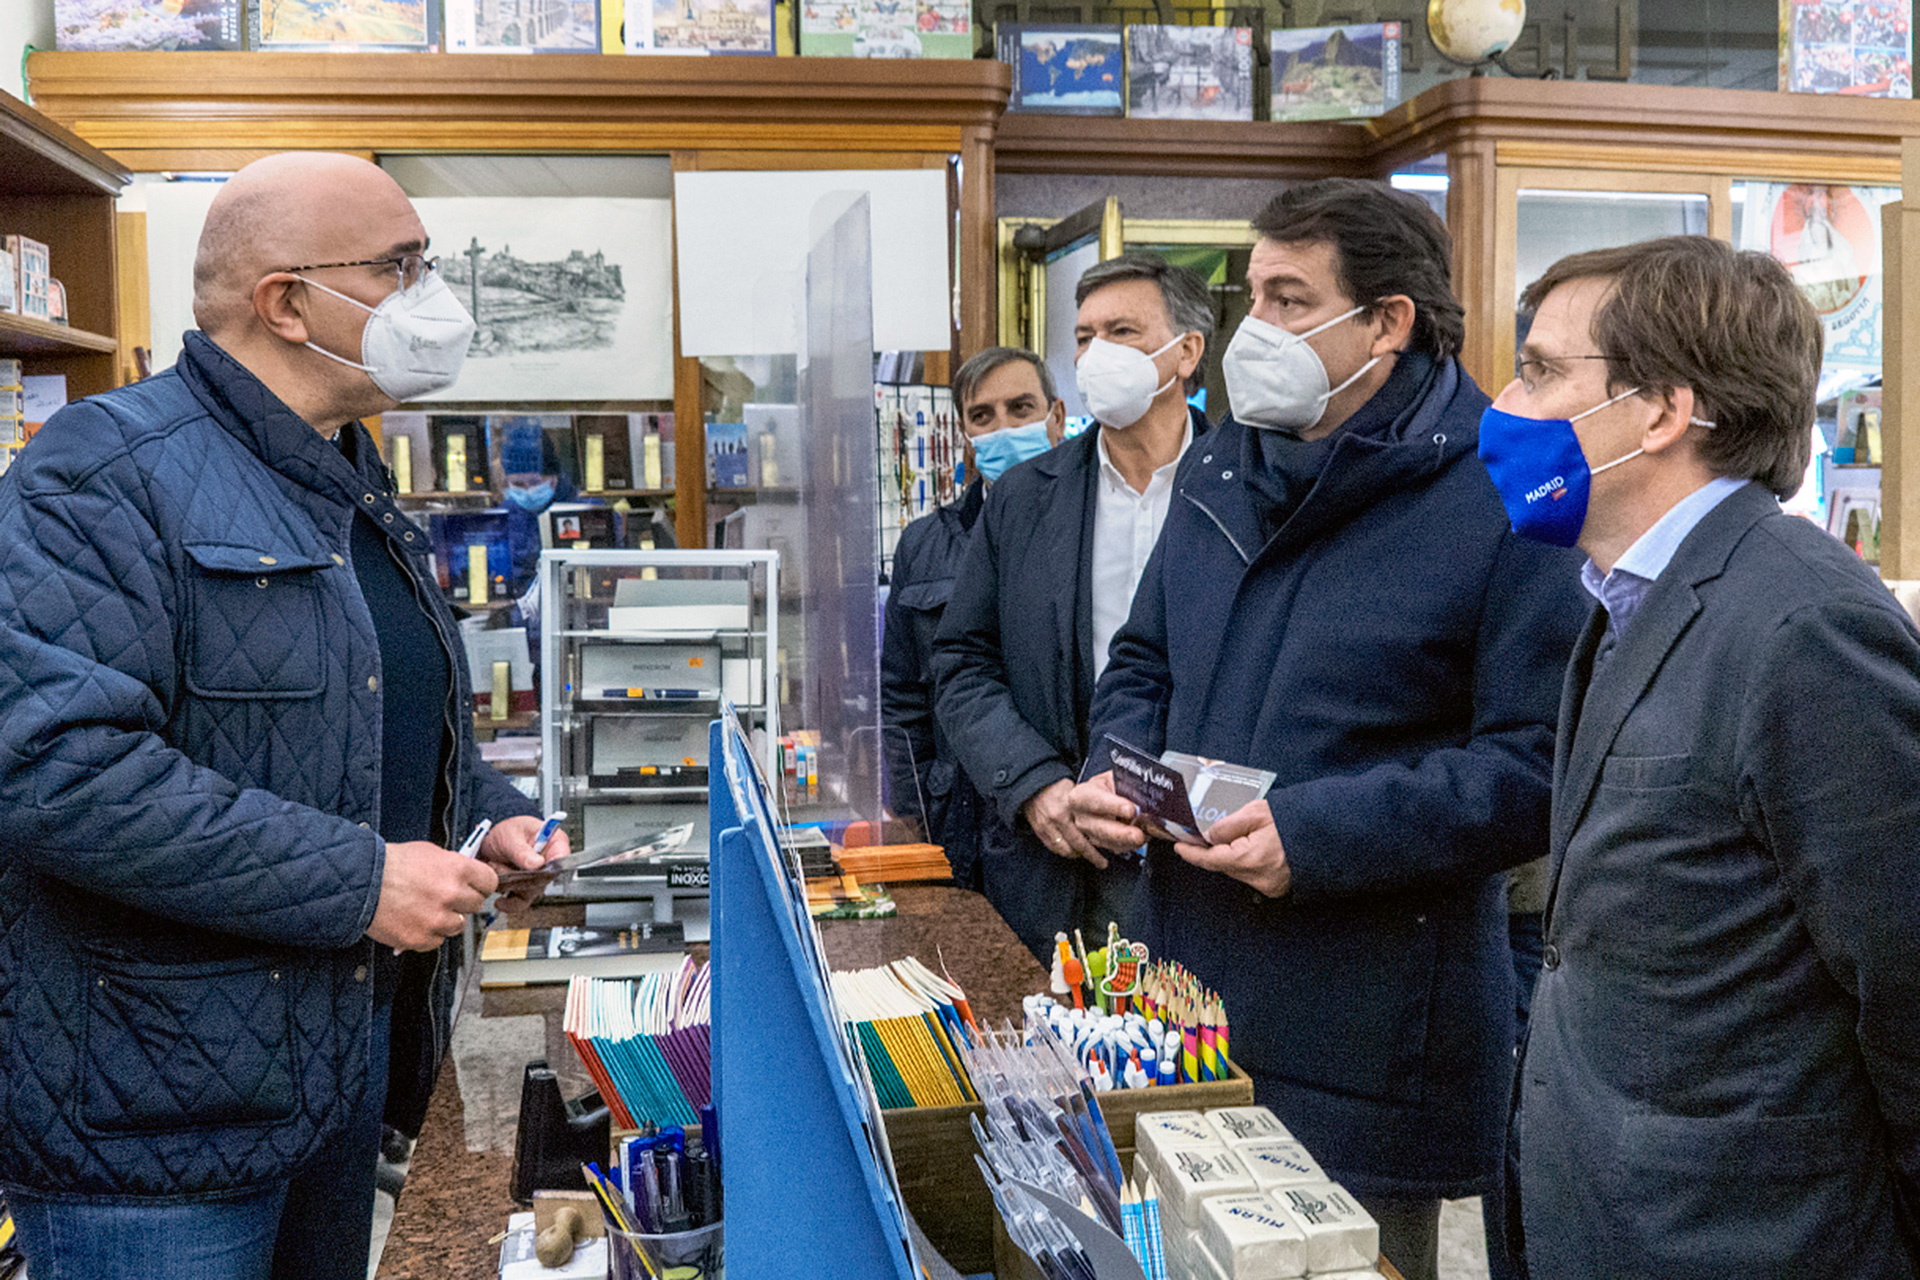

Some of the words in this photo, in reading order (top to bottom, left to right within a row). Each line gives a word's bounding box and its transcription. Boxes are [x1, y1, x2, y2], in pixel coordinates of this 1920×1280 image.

[220, 6, 230, 40] EDUCA
[229, 6, 238, 43] PUZZLE
[1237, 45, 1251, 78] 1000
[1387, 40, 1398, 73] 1000
[1524, 475, 1565, 504] MADRID
[1160, 1120, 1209, 1141] MILAN
[1258, 1151, 1311, 1175] MILAN
[1228, 1207, 1285, 1229] MILAN
